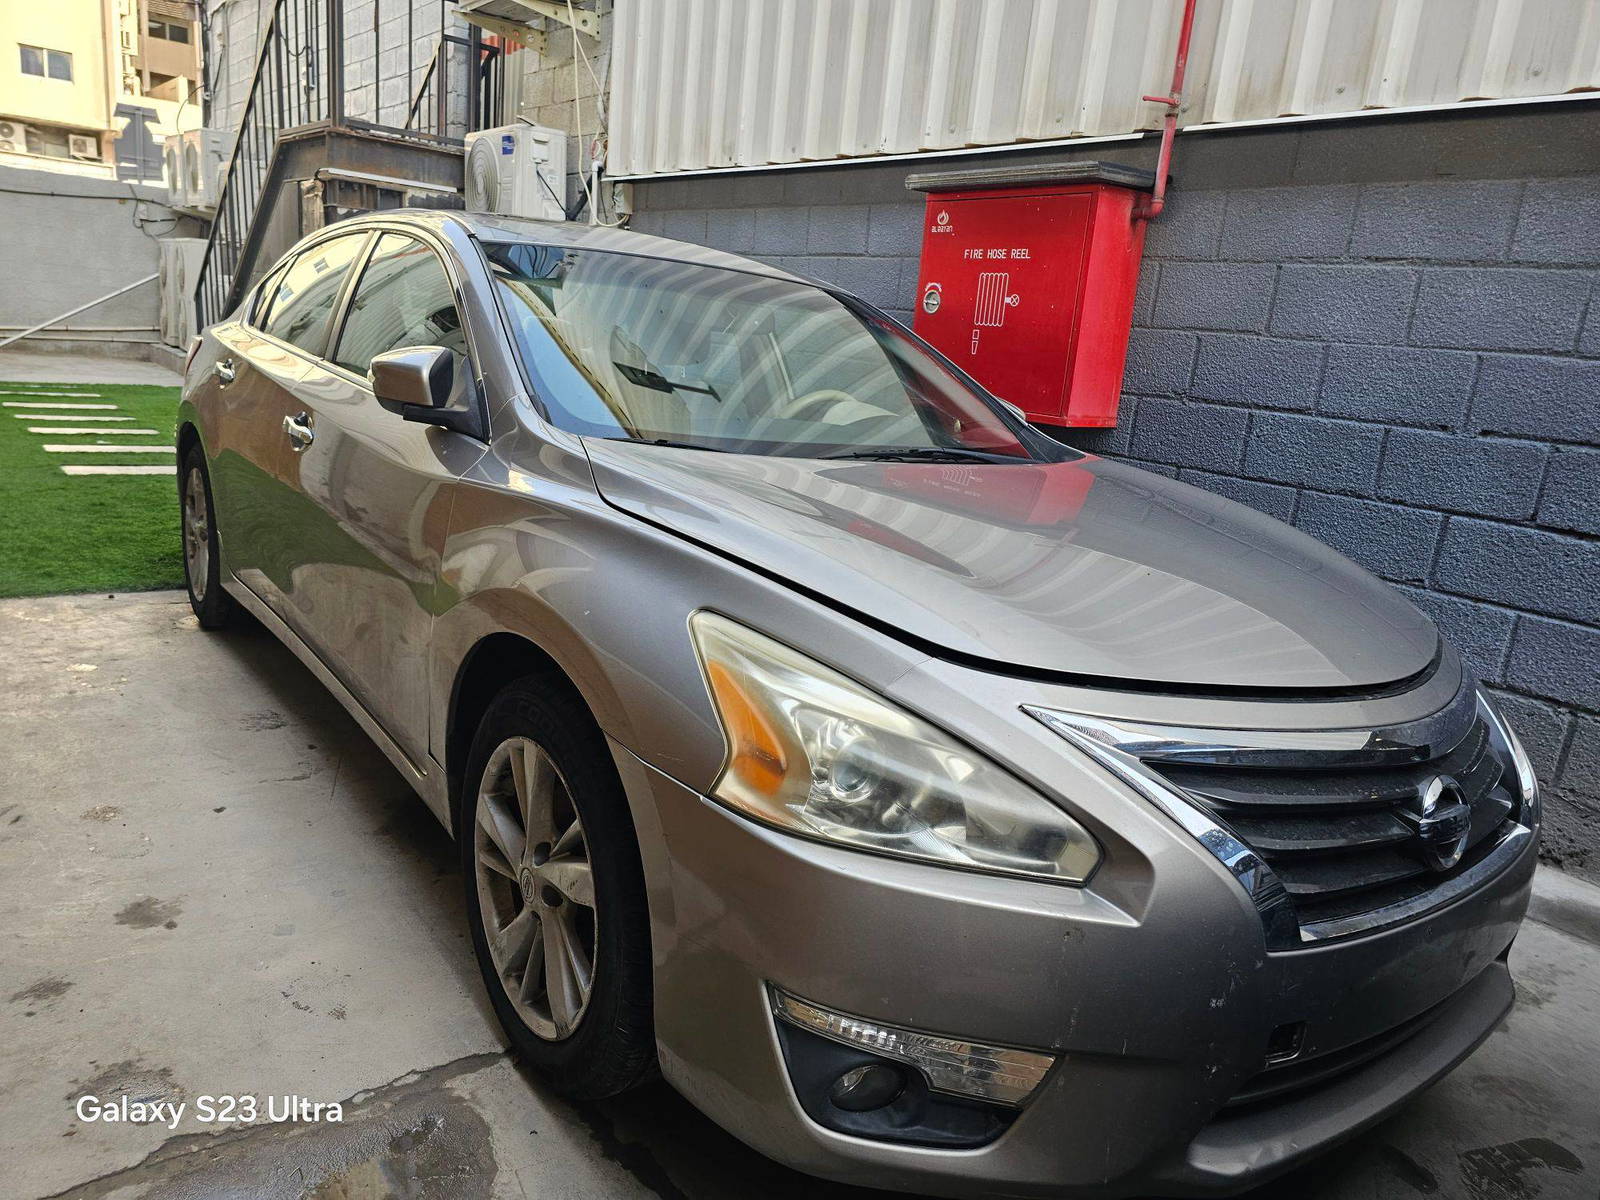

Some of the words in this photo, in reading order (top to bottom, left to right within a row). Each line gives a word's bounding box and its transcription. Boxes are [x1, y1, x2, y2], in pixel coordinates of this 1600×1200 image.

[964, 249, 984, 259] FIRE
[987, 248, 1007, 259] HOSE
[1010, 248, 1031, 259] REEL
